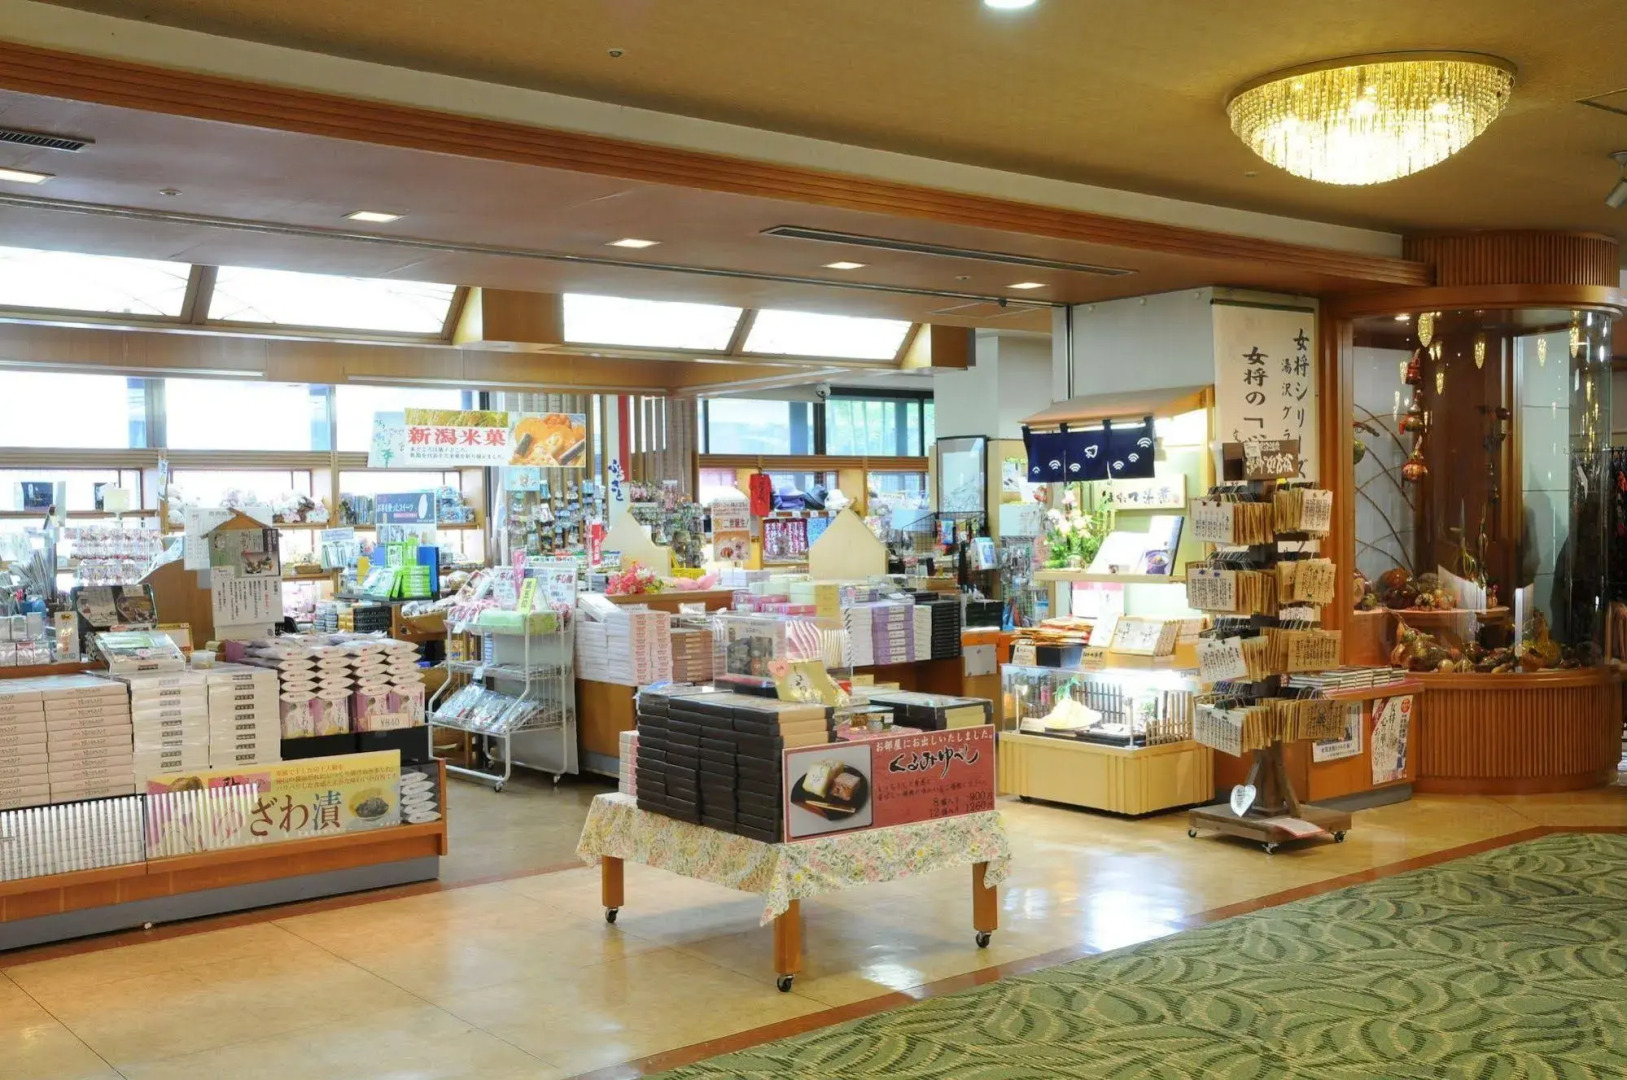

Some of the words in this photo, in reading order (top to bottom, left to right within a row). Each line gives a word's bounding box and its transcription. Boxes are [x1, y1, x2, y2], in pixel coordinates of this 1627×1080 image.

[408, 427, 507, 447] 新潟米菓
[876, 730, 993, 752] お部屋にお出しいたしました。
[888, 745, 979, 779] くるみゆべし
